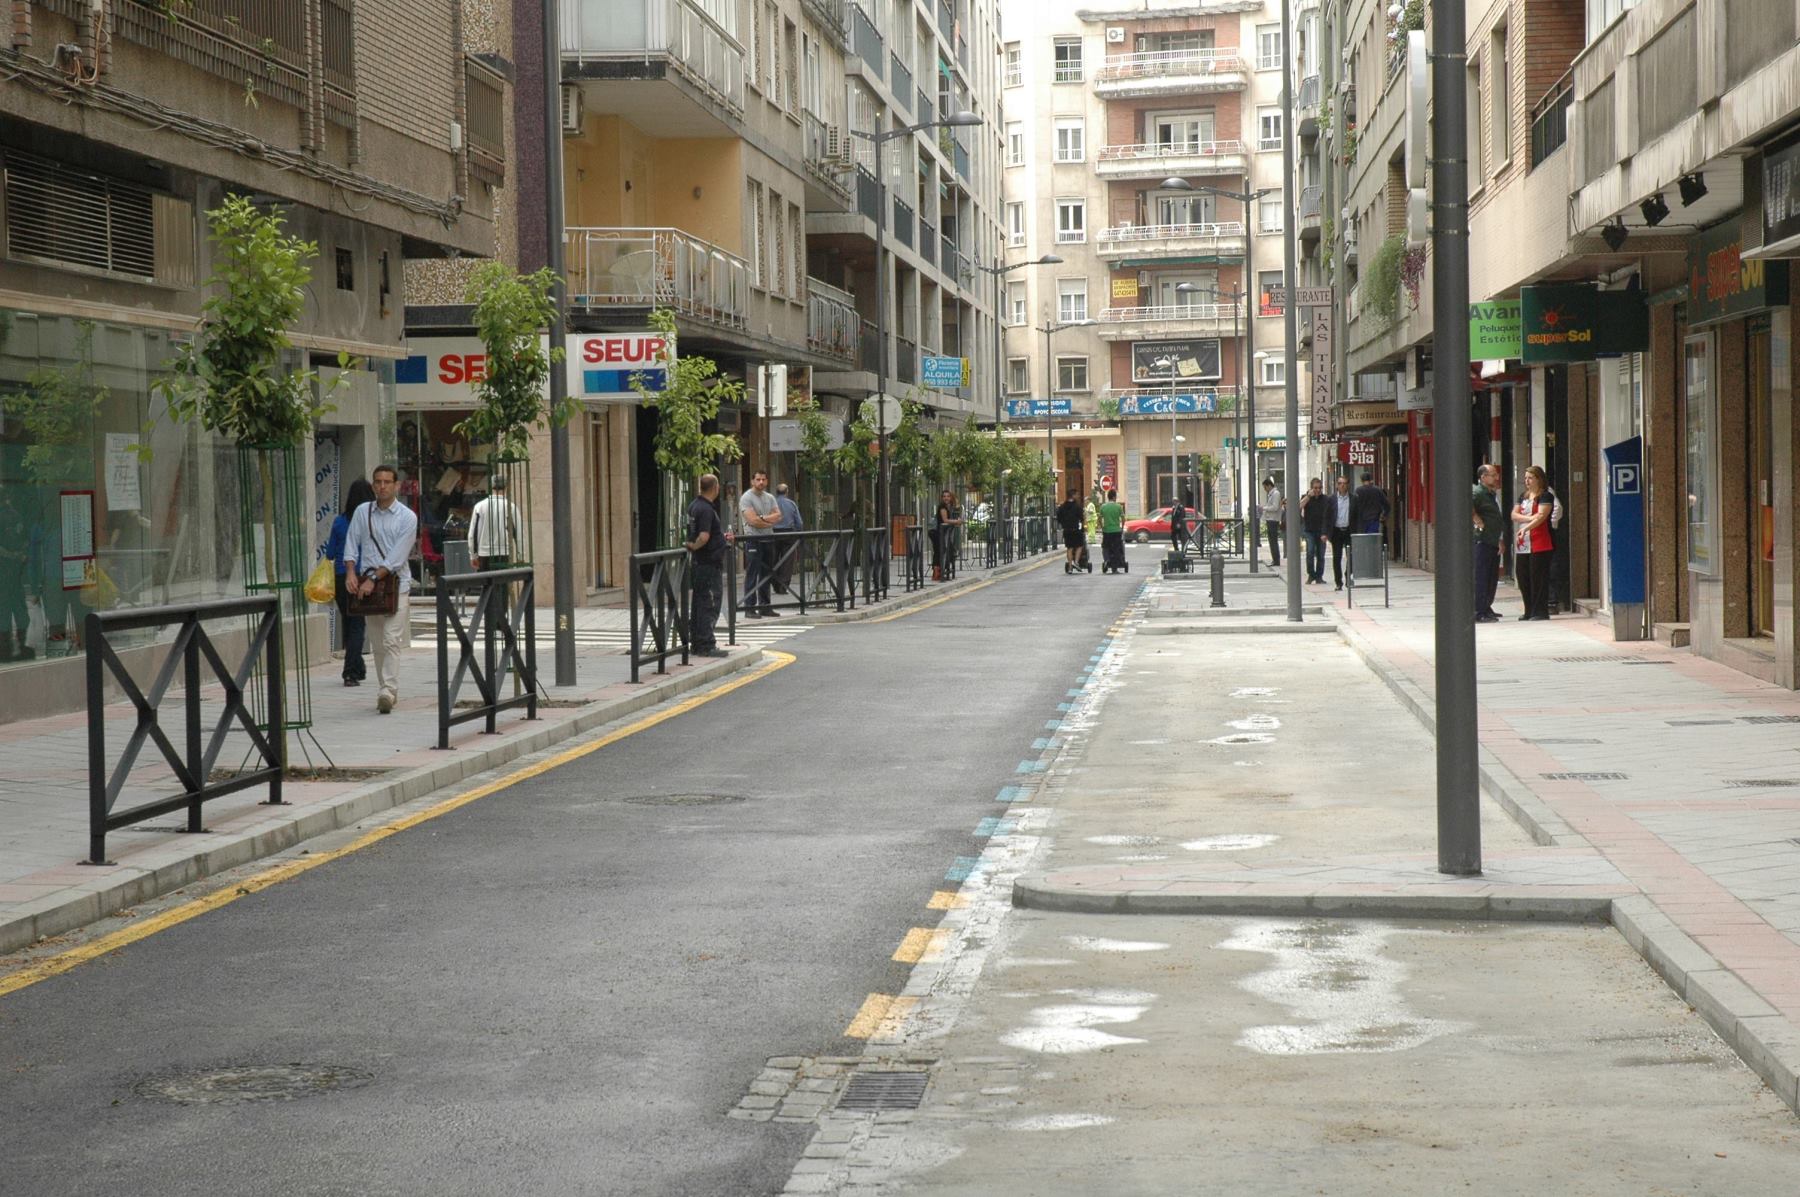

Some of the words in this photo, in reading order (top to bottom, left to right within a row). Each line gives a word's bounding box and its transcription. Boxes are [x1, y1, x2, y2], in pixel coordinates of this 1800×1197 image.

[1270, 290, 1330, 303] RESURANTE
[1316, 313, 1328, 341] LAS
[1527, 328, 1591, 346] superSol
[1316, 354, 1328, 424] TINAJAS
[1618, 469, 1634, 489] P
